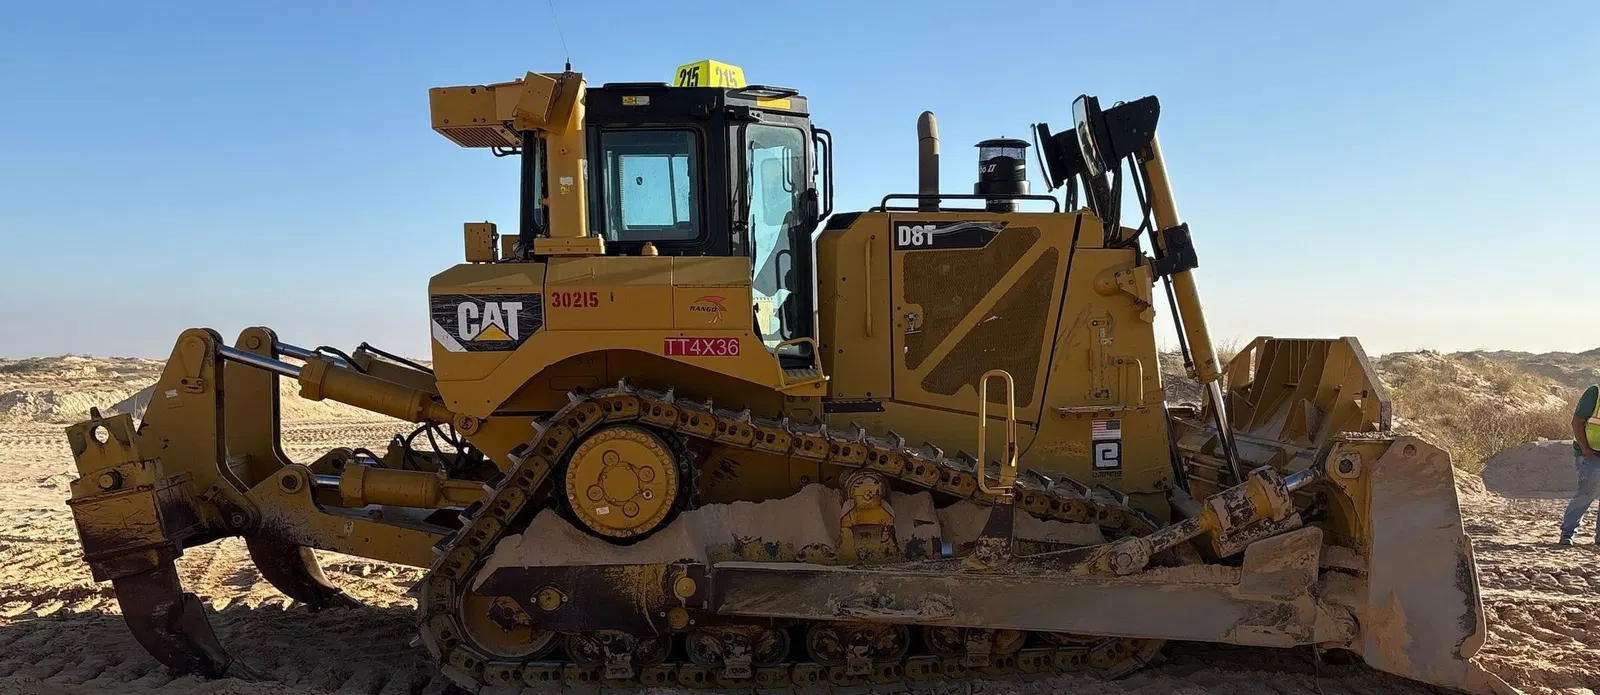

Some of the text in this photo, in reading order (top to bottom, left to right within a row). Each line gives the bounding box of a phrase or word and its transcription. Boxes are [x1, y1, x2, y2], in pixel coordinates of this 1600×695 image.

[680, 66, 700, 87] 215
[715, 67, 738, 88] 215
[898, 224, 936, 246] D8T
[551, 292, 599, 308] 30215
[457, 301, 523, 341] CAT
[665, 338, 739, 355] TT4X36
